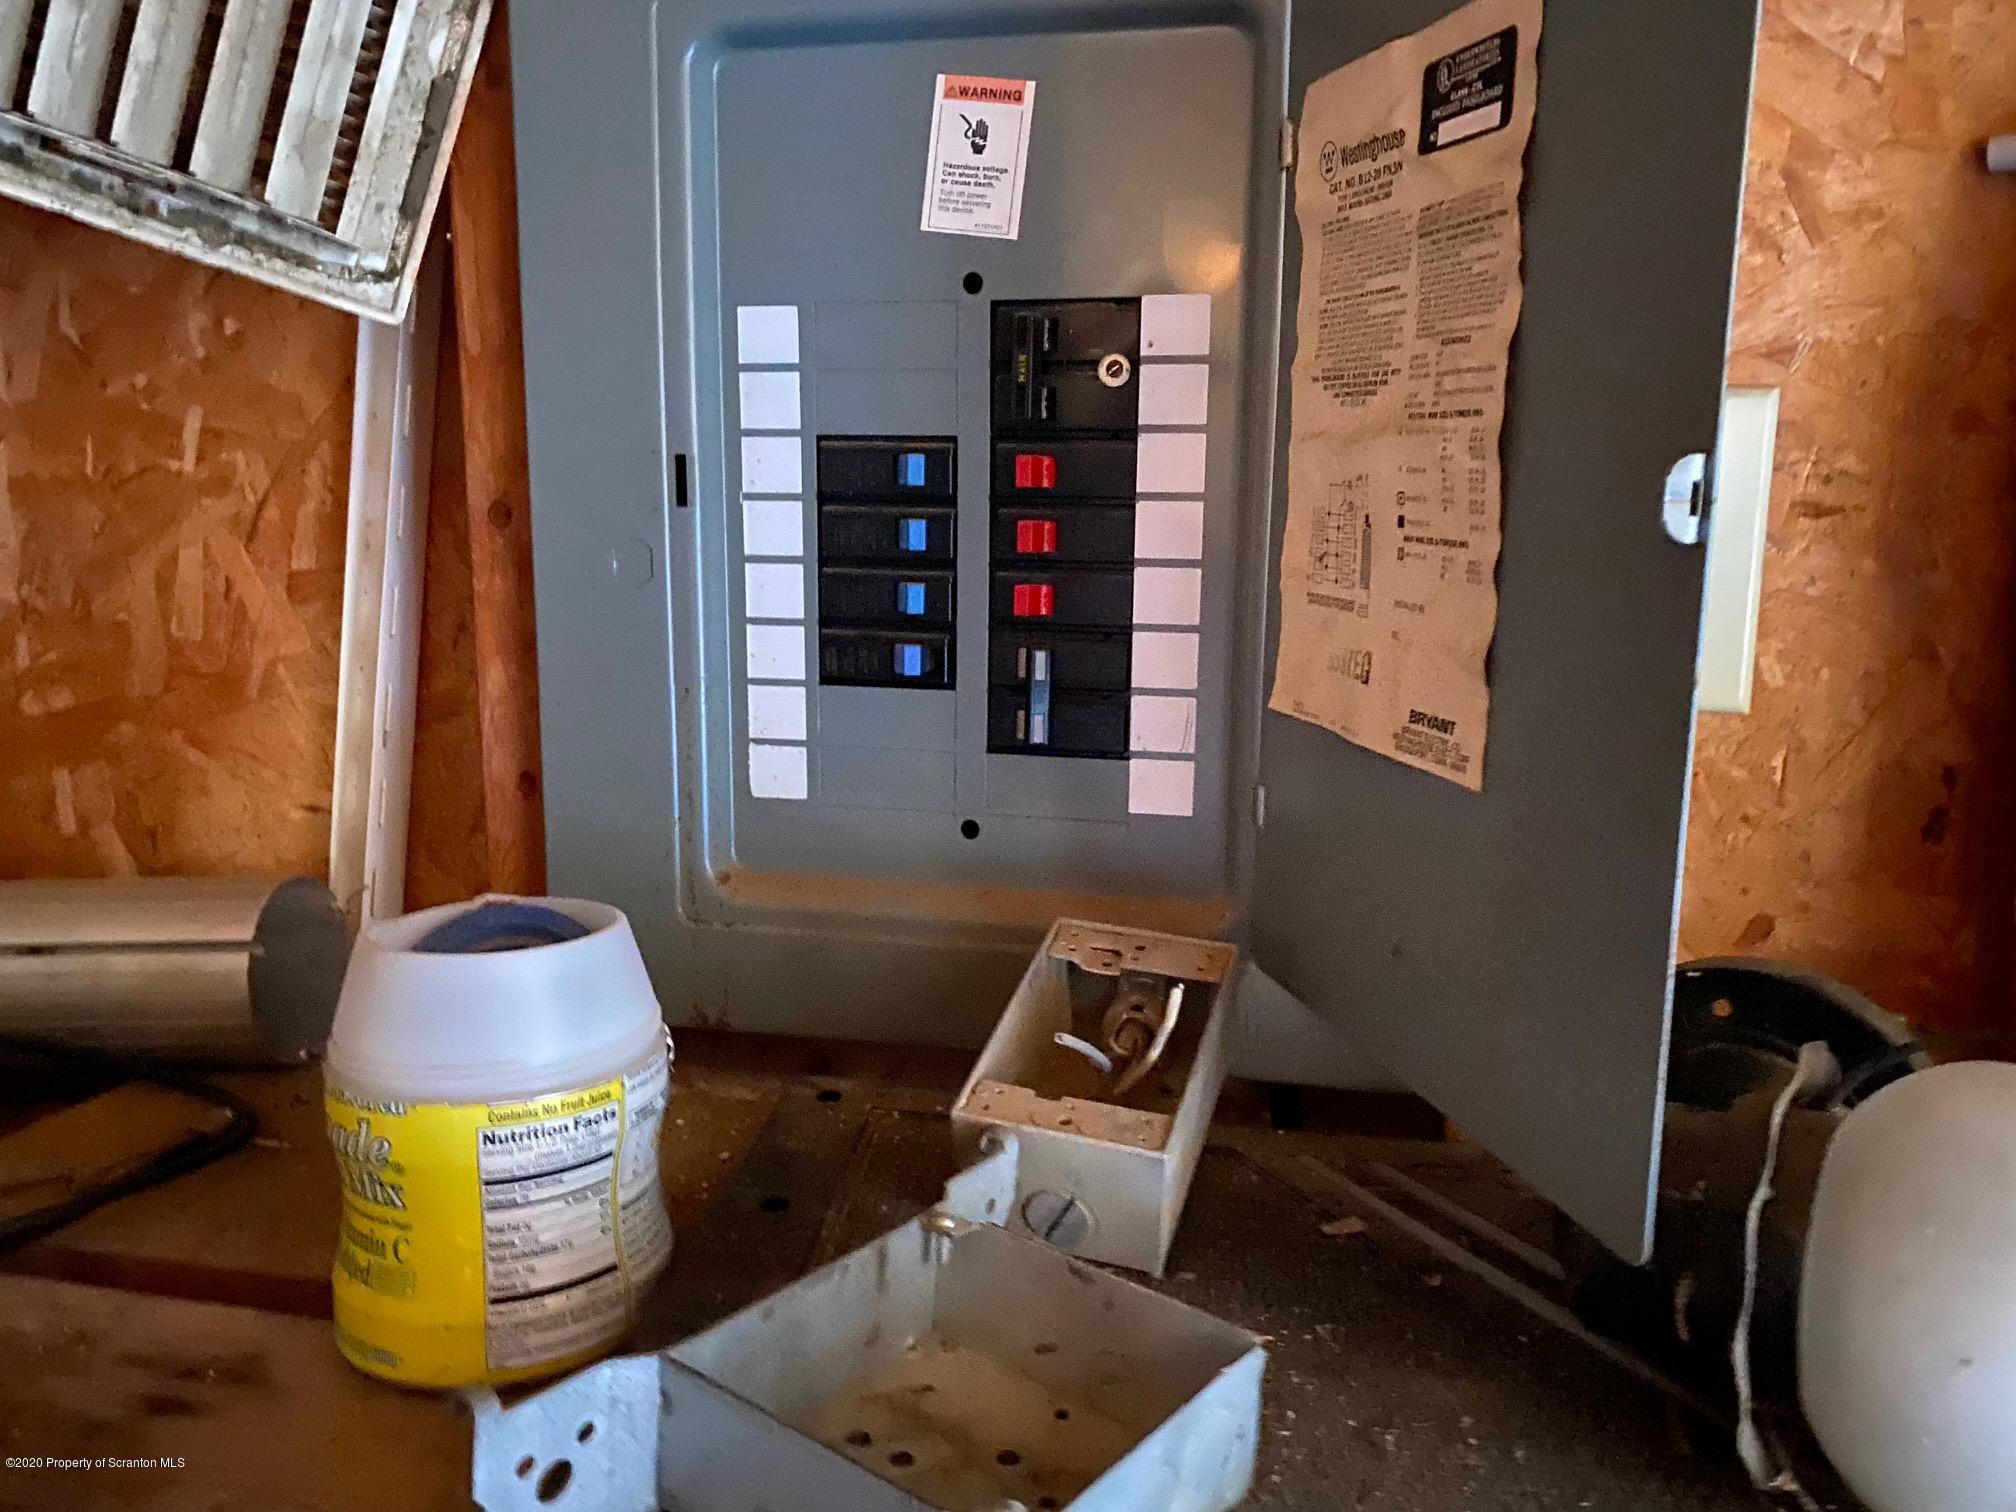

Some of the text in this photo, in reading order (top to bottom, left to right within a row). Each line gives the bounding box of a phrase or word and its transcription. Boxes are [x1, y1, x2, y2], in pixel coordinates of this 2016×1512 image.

[959, 85, 1022, 101] WARNING
[1340, 128, 1406, 167] Westinghouse
[1408, 709, 1457, 736] BRYANT
[488, 1089, 611, 1124] Contains No Fruit Juice
[327, 1117, 391, 1168] ade
[482, 1122, 569, 1146] Nutrition
[574, 1107, 616, 1131] Facts
